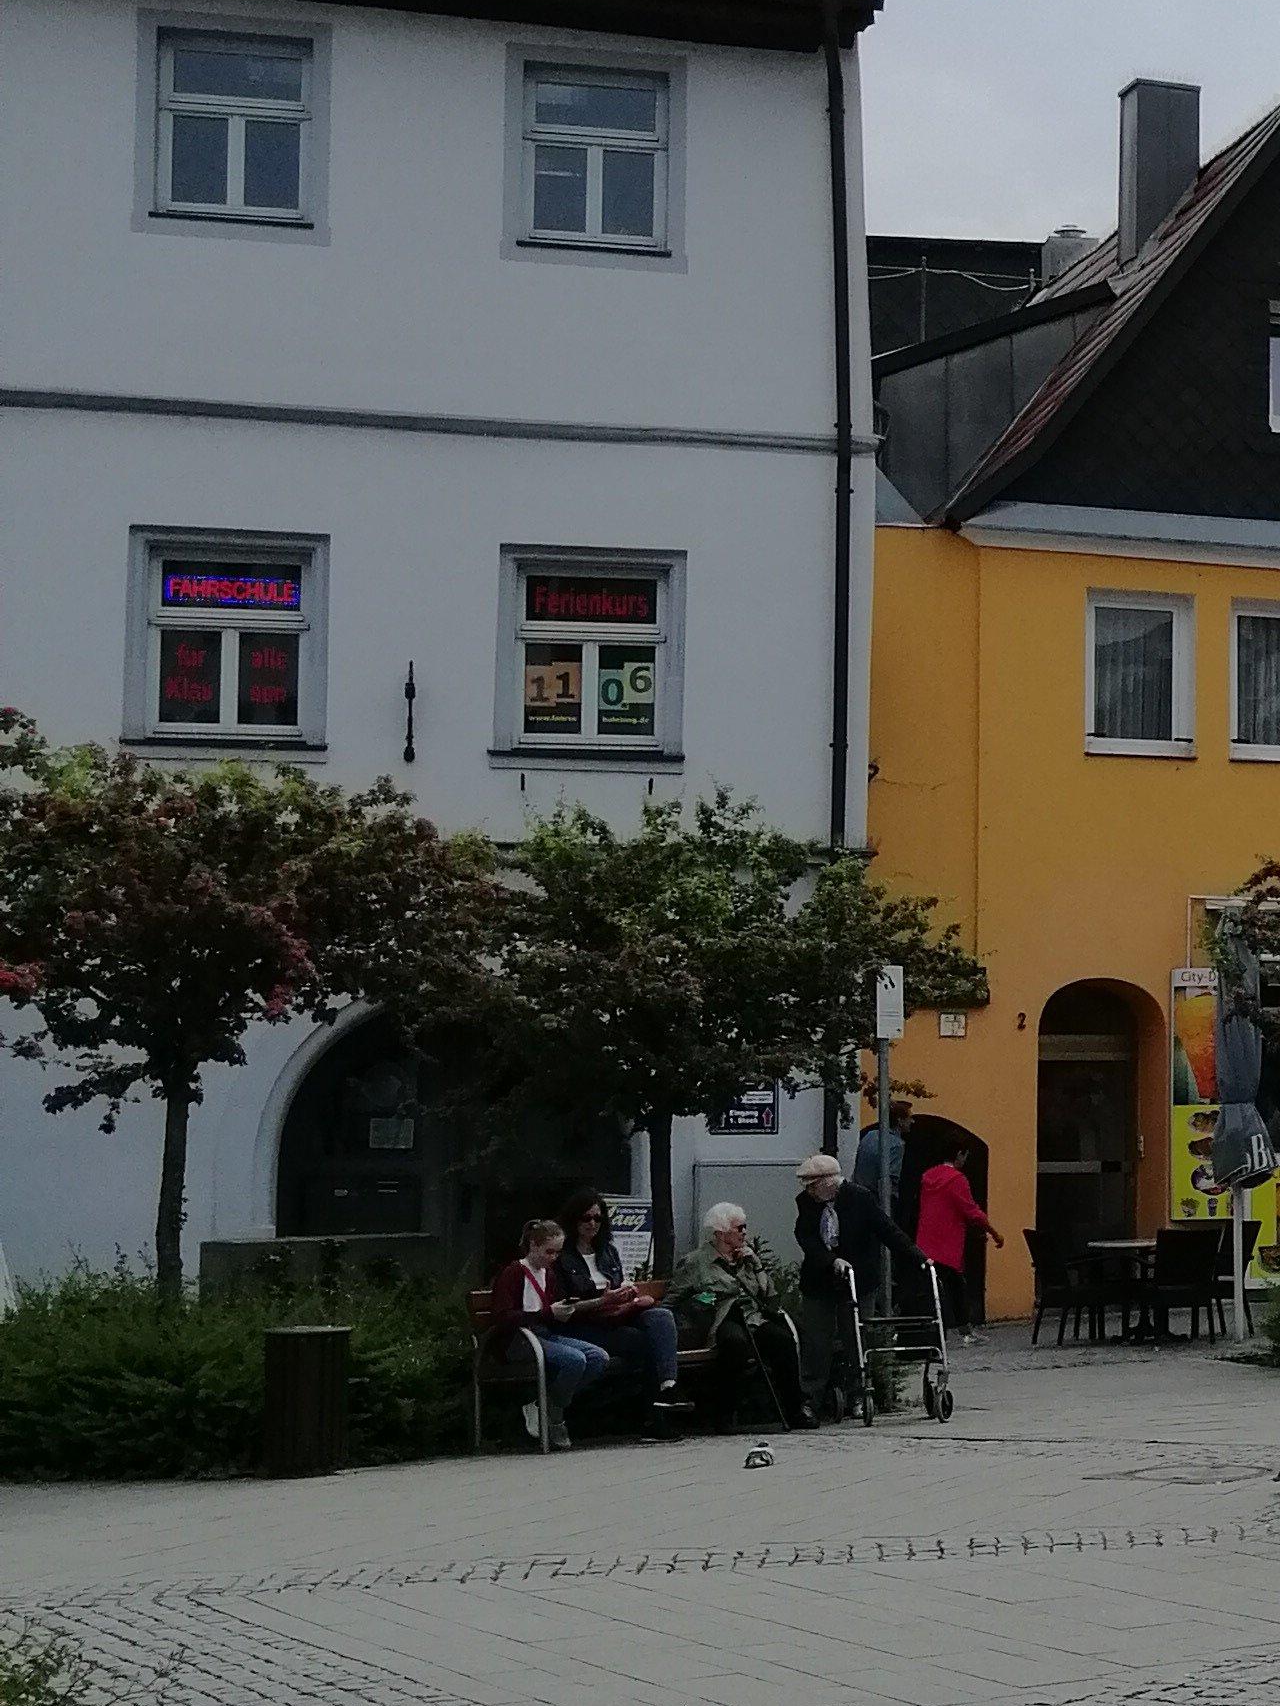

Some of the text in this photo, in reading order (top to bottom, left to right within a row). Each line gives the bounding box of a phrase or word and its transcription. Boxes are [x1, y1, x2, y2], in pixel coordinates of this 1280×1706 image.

[170, 577, 294, 602] FAHRSCHULE
[534, 583, 650, 618] Ferienkurs
[1180, 971, 1218, 985] City-D
